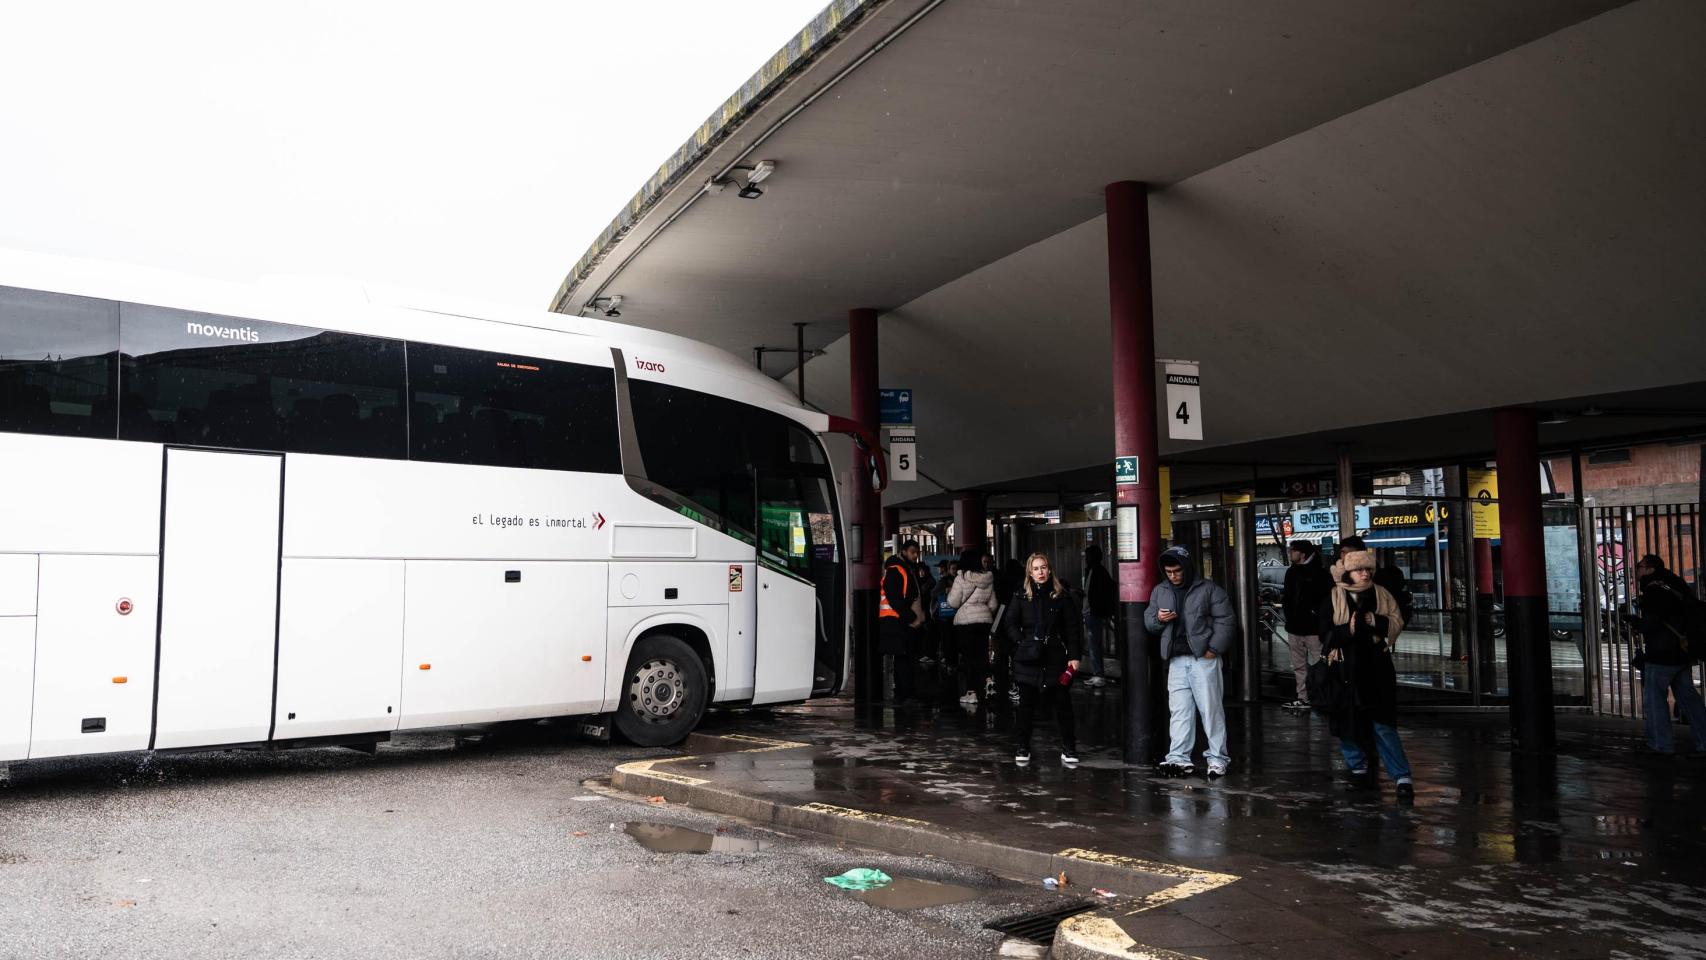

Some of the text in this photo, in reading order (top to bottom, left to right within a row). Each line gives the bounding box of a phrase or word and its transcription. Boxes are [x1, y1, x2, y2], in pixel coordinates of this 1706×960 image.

[187, 322, 259, 342] moventis
[1168, 375, 1198, 385] ANDANA
[1176, 401, 1190, 424] 4
[899, 454, 910, 470] 5
[490, 514, 524, 529] legado
[529, 518, 540, 527] es
[546, 516, 587, 529] inmortal
[1300, 512, 1330, 525] ENTRE
[1373, 515, 1419, 526] CAFETERIA
